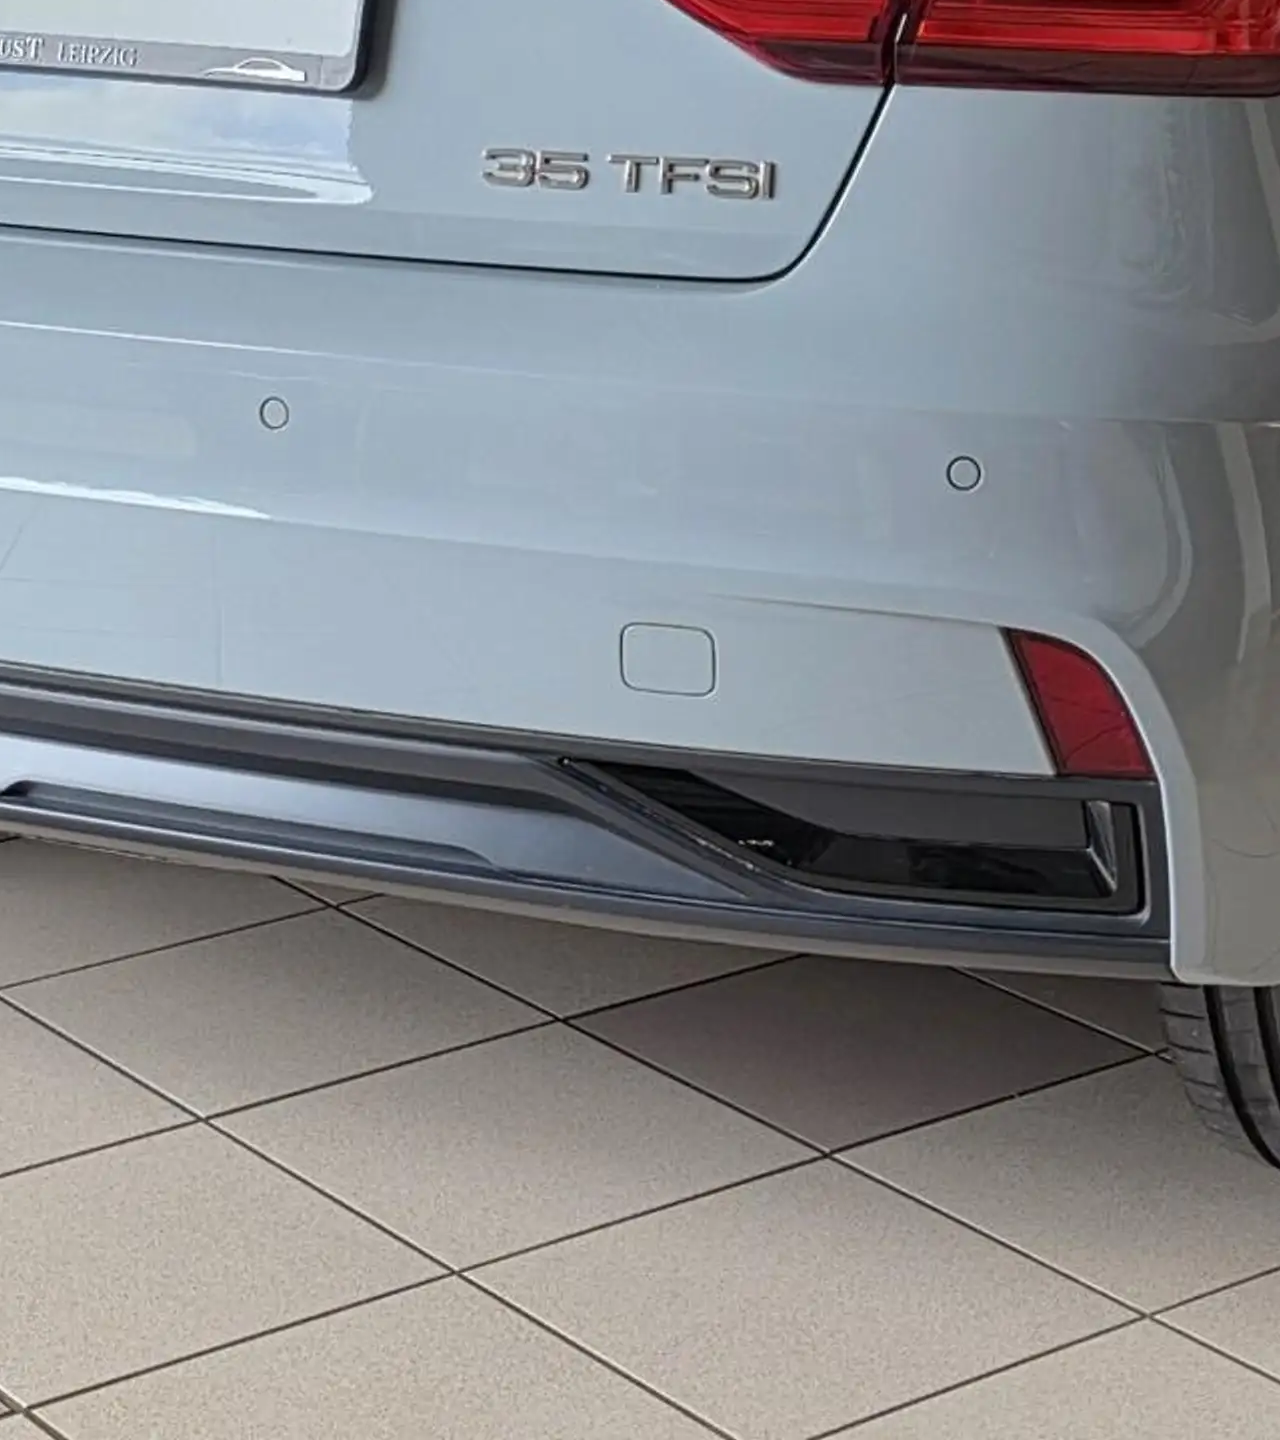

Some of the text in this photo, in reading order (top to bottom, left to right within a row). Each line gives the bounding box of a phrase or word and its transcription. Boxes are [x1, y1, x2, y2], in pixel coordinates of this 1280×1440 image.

[57, 41, 138, 67] LEIPZIG
[482, 148, 777, 199] 35 TFSI
